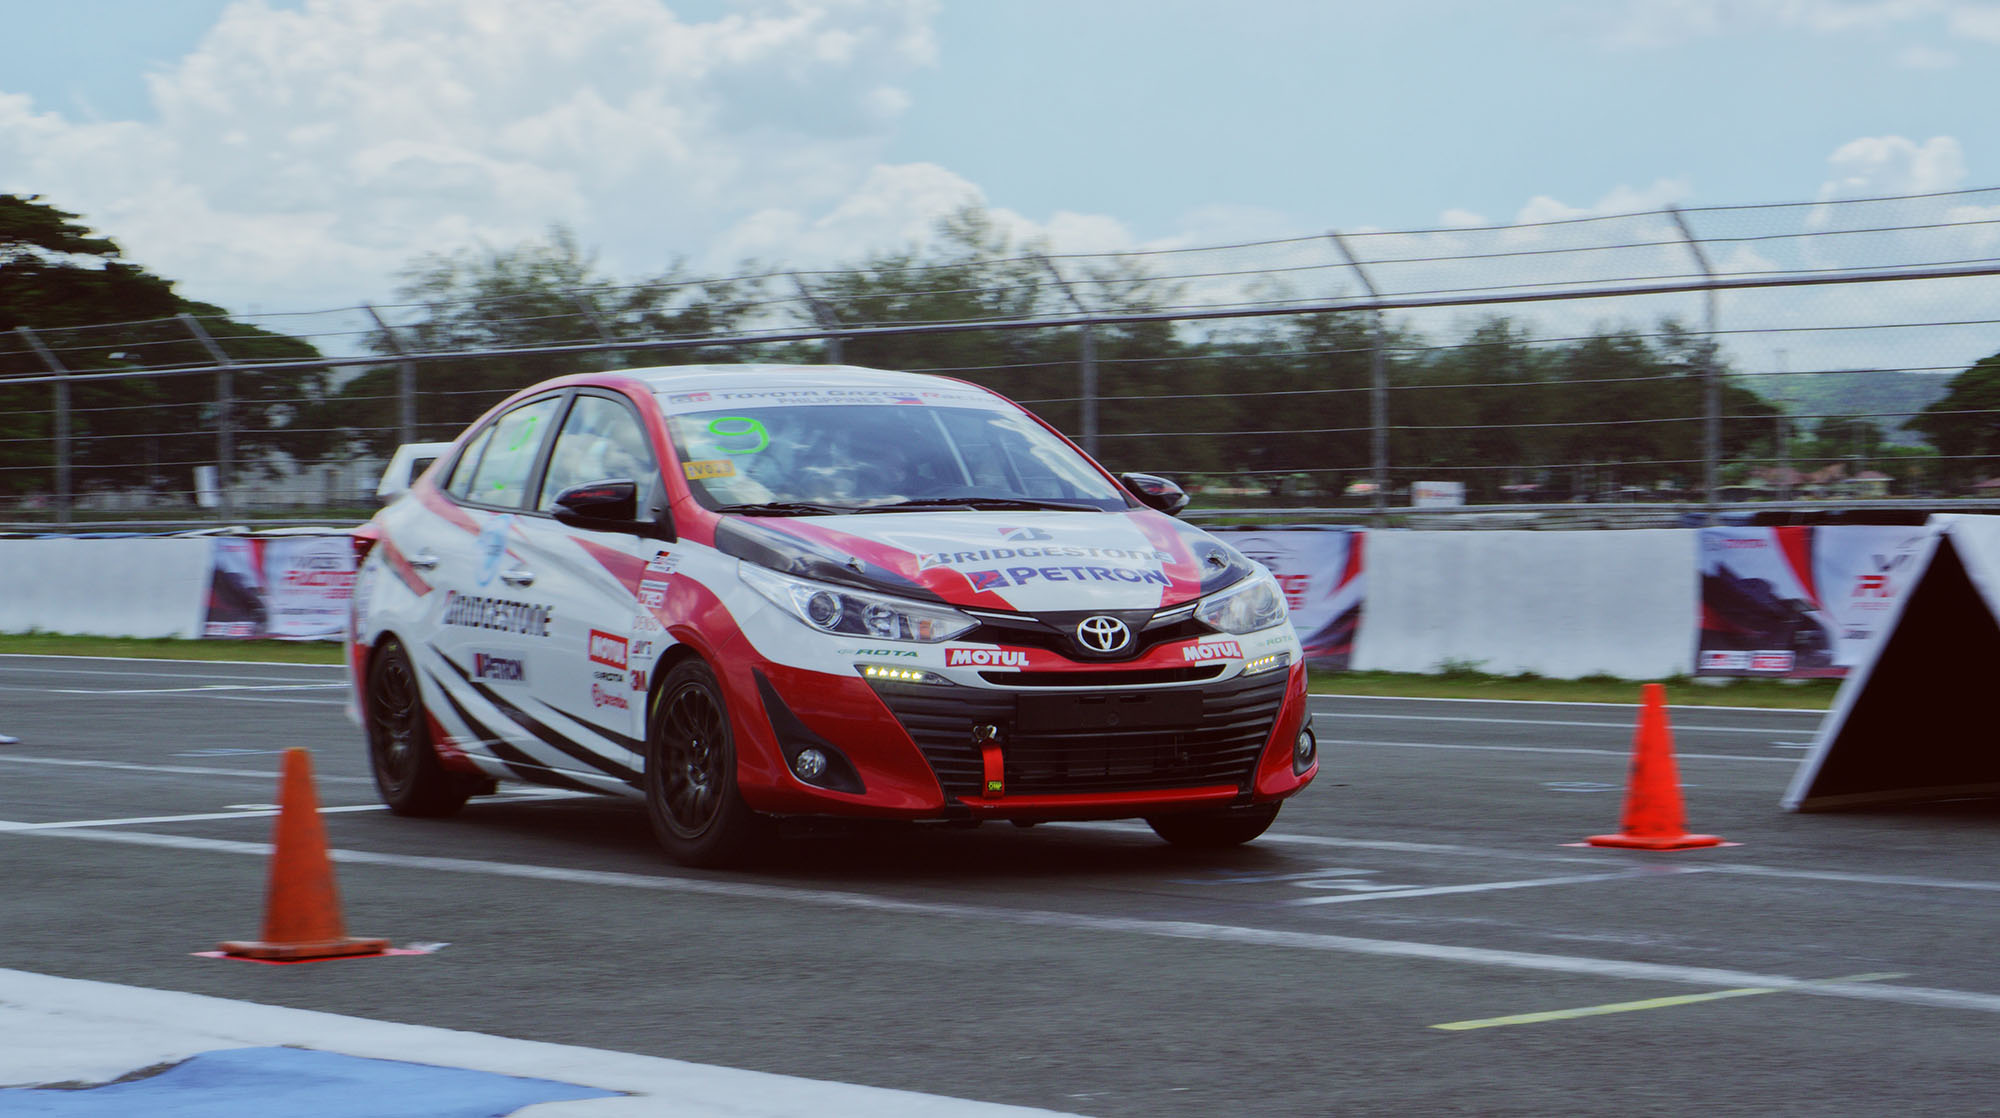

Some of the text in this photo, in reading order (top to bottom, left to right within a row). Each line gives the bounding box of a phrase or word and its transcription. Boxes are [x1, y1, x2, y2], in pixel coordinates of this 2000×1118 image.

[718, 391, 819, 400] TOYOTA
[708, 417, 769, 455] 9
[922, 546, 1175, 568] BRIDGESTONE
[1006, 566, 1170, 586] PETRON
[856, 649, 919, 658] ROTA
[950, 650, 1030, 666] MOTUL
[1183, 642, 1240, 661] MOTUL
